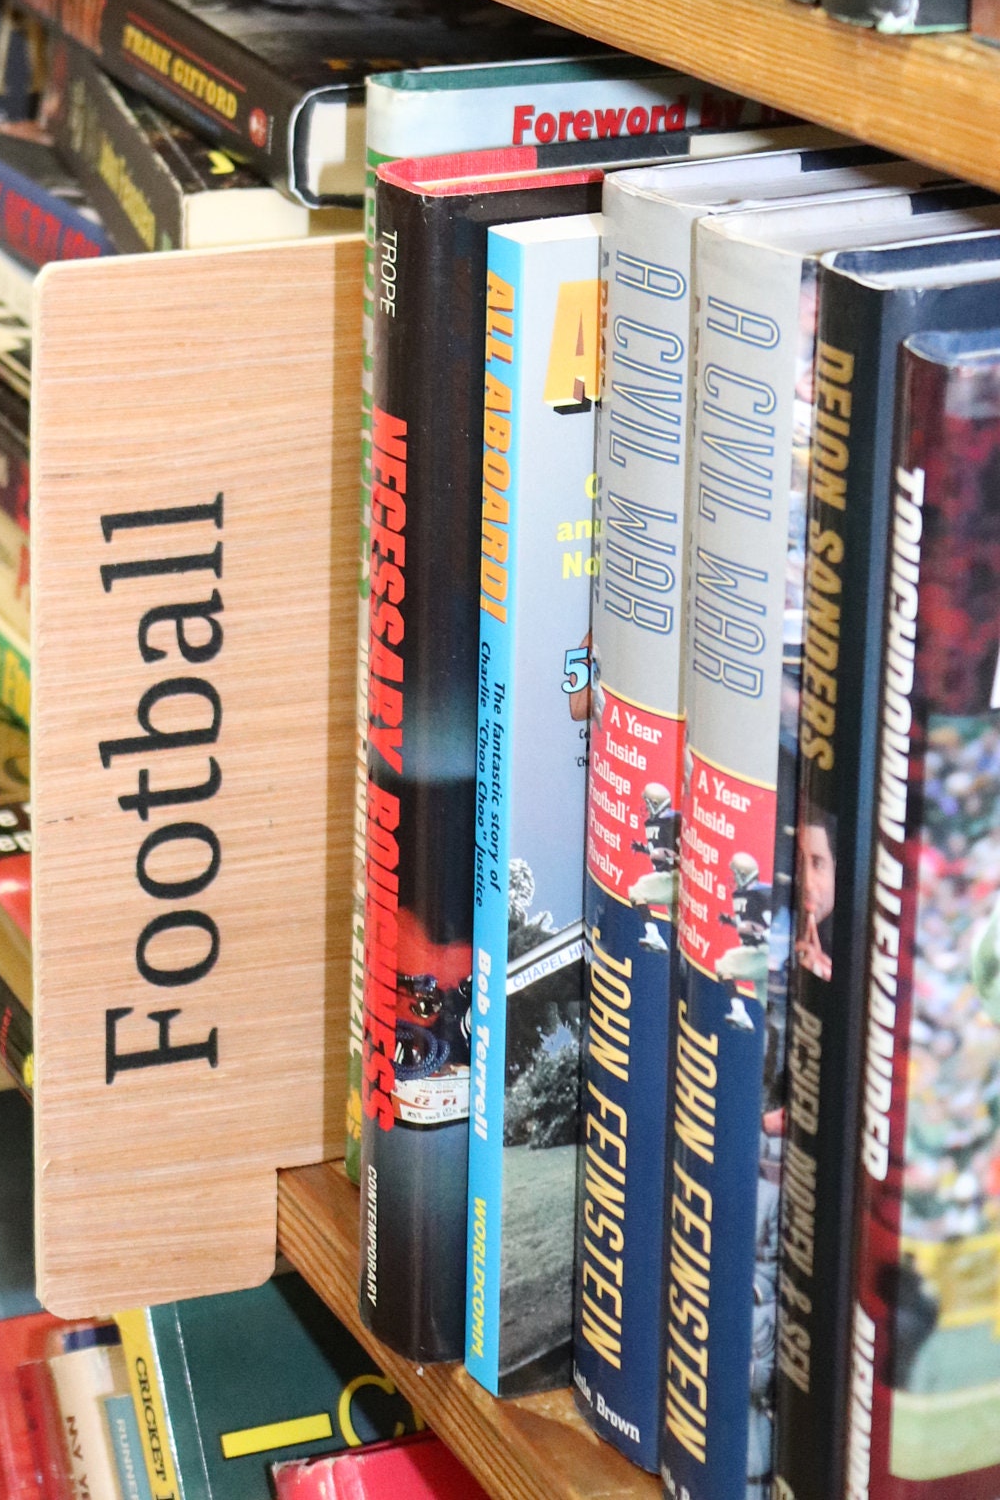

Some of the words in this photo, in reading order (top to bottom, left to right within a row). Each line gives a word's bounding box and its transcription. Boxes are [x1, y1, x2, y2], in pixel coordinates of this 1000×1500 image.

[121, 23, 175, 73] FRANK
[168, 45, 238, 118] GIFFORD
[511, 100, 690, 145] Foreword
[379, 229, 399, 318] TROPE
[485, 269, 516, 365] ALL
[617, 256, 687, 302] A
[708, 296, 782, 350] A
[607, 315, 684, 470] CIVIL
[812, 341, 856, 513] DEION
[698, 362, 778, 523] CIVIL
[480, 370, 512, 625] ABOARD!
[368, 404, 408, 776] NECESSARY
[602, 489, 678, 638] WAR
[692, 546, 769, 700] WAR
[798, 520, 843, 772] SANDERS
[878, 466, 926, 844] TOUCHDOWN
[480, 640, 492, 709] Charlie
[494, 681, 507, 716] The
[479, 718, 491, 774] "Choo
[490, 720, 505, 806] fantastic
[593, 752, 633, 795] College
[604, 736, 648, 773] Inside
[609, 705, 623, 729] A
[624, 709, 662, 749] Year
[96, 490, 226, 1085] Football
[477, 780, 490, 839] Choo"
[691, 798, 736, 840] Inside
[698, 770, 712, 795] A
[712, 775, 752, 813] Year
[474, 843, 487, 909] Justice
[489, 813, 502, 866] story
[489, 870, 501, 894] of
[362, 777, 401, 1133] ROUGHNESS
[476, 947, 494, 1001] Bob
[588, 927, 634, 1081] JOHN
[859, 842, 905, 1183] ALEXANDER
[473, 1005, 493, 1141] Terrell
[673, 999, 719, 1163] JOHN
[365, 1163, 378, 1307] CONTEMPORARY
[582, 1080, 629, 1370] FEINSTEIN
[470, 1196, 488, 1359] WORLDCOMM
[666, 1161, 715, 1466] FEINSTEIN
[135, 1356, 168, 1483] CRICKET
[595, 1391, 641, 1444] Brown
